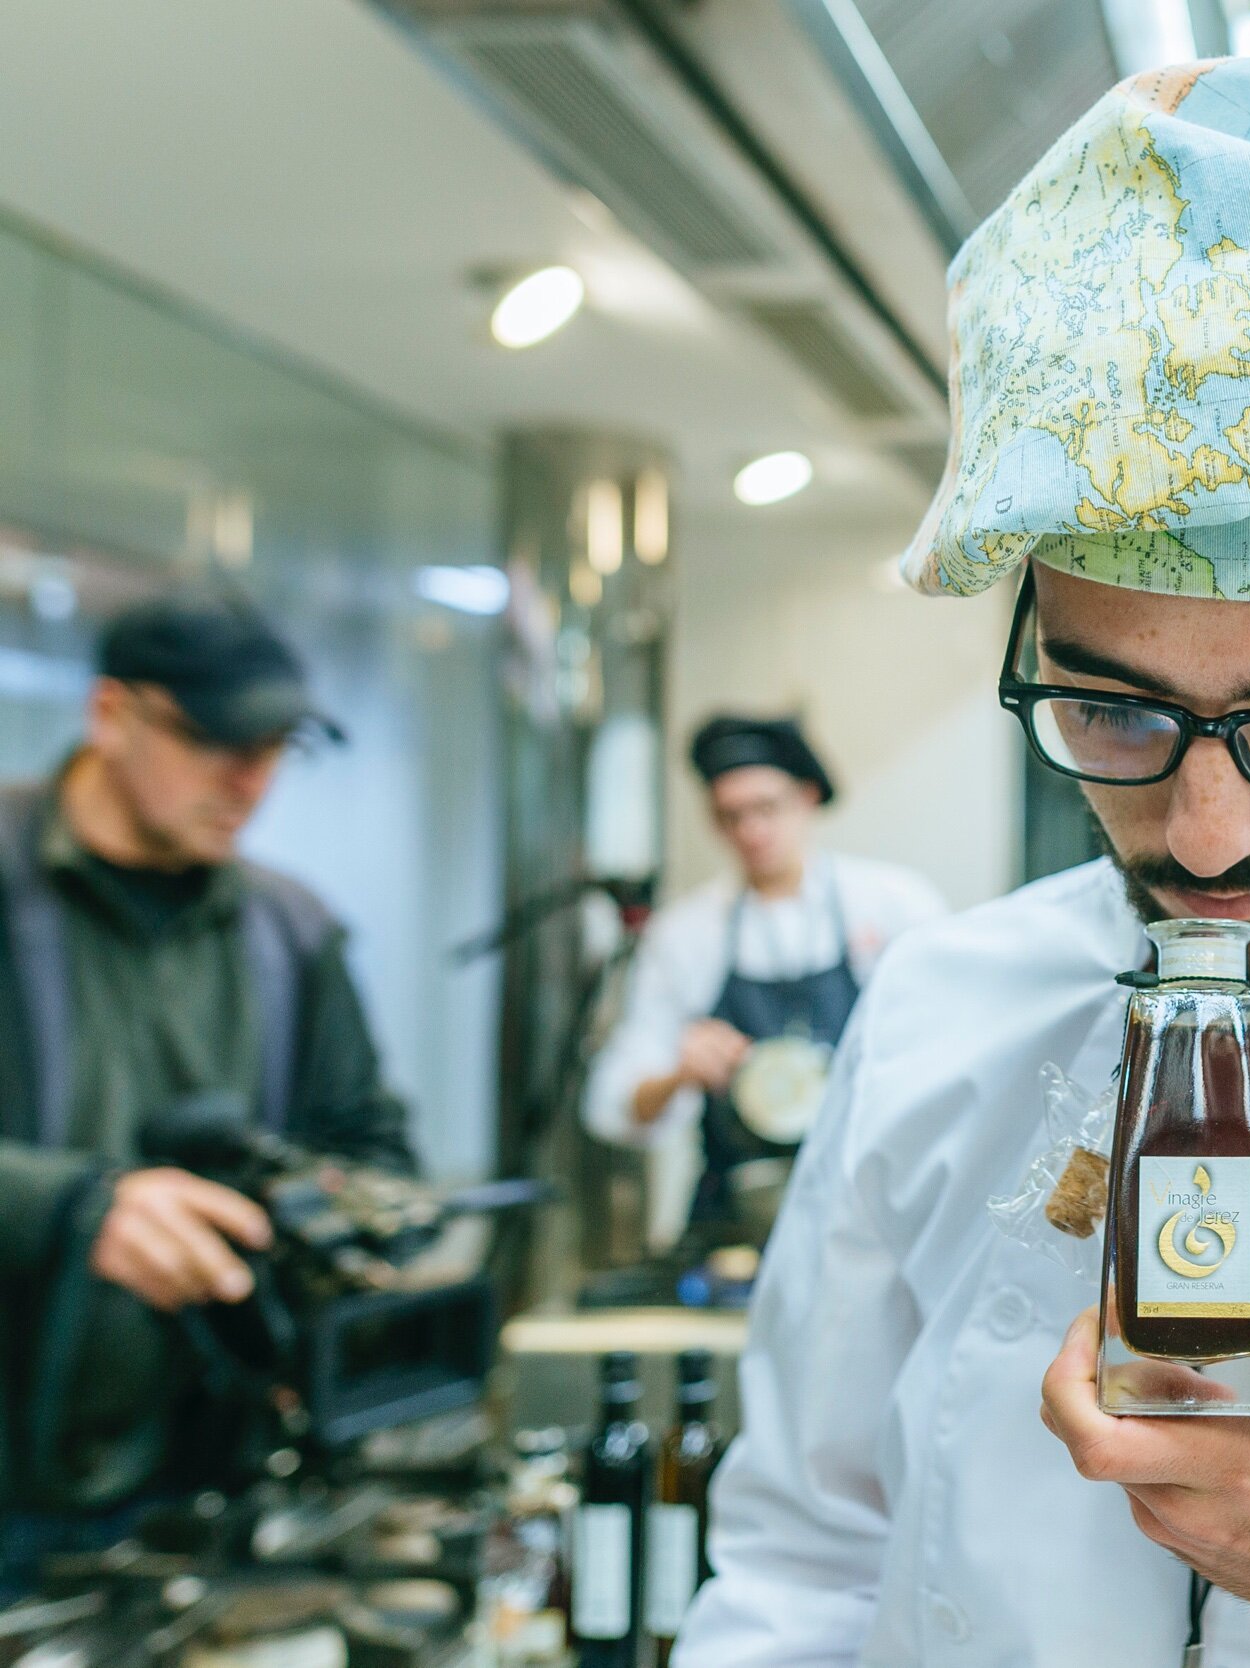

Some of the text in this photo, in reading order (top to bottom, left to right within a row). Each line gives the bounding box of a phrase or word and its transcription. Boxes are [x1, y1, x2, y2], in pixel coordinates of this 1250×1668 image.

[1150, 1180, 1217, 1209] Vinagre
[1180, 1212, 1194, 1224] de
[1166, 1281, 1225, 1291] GRAN RESERVA
